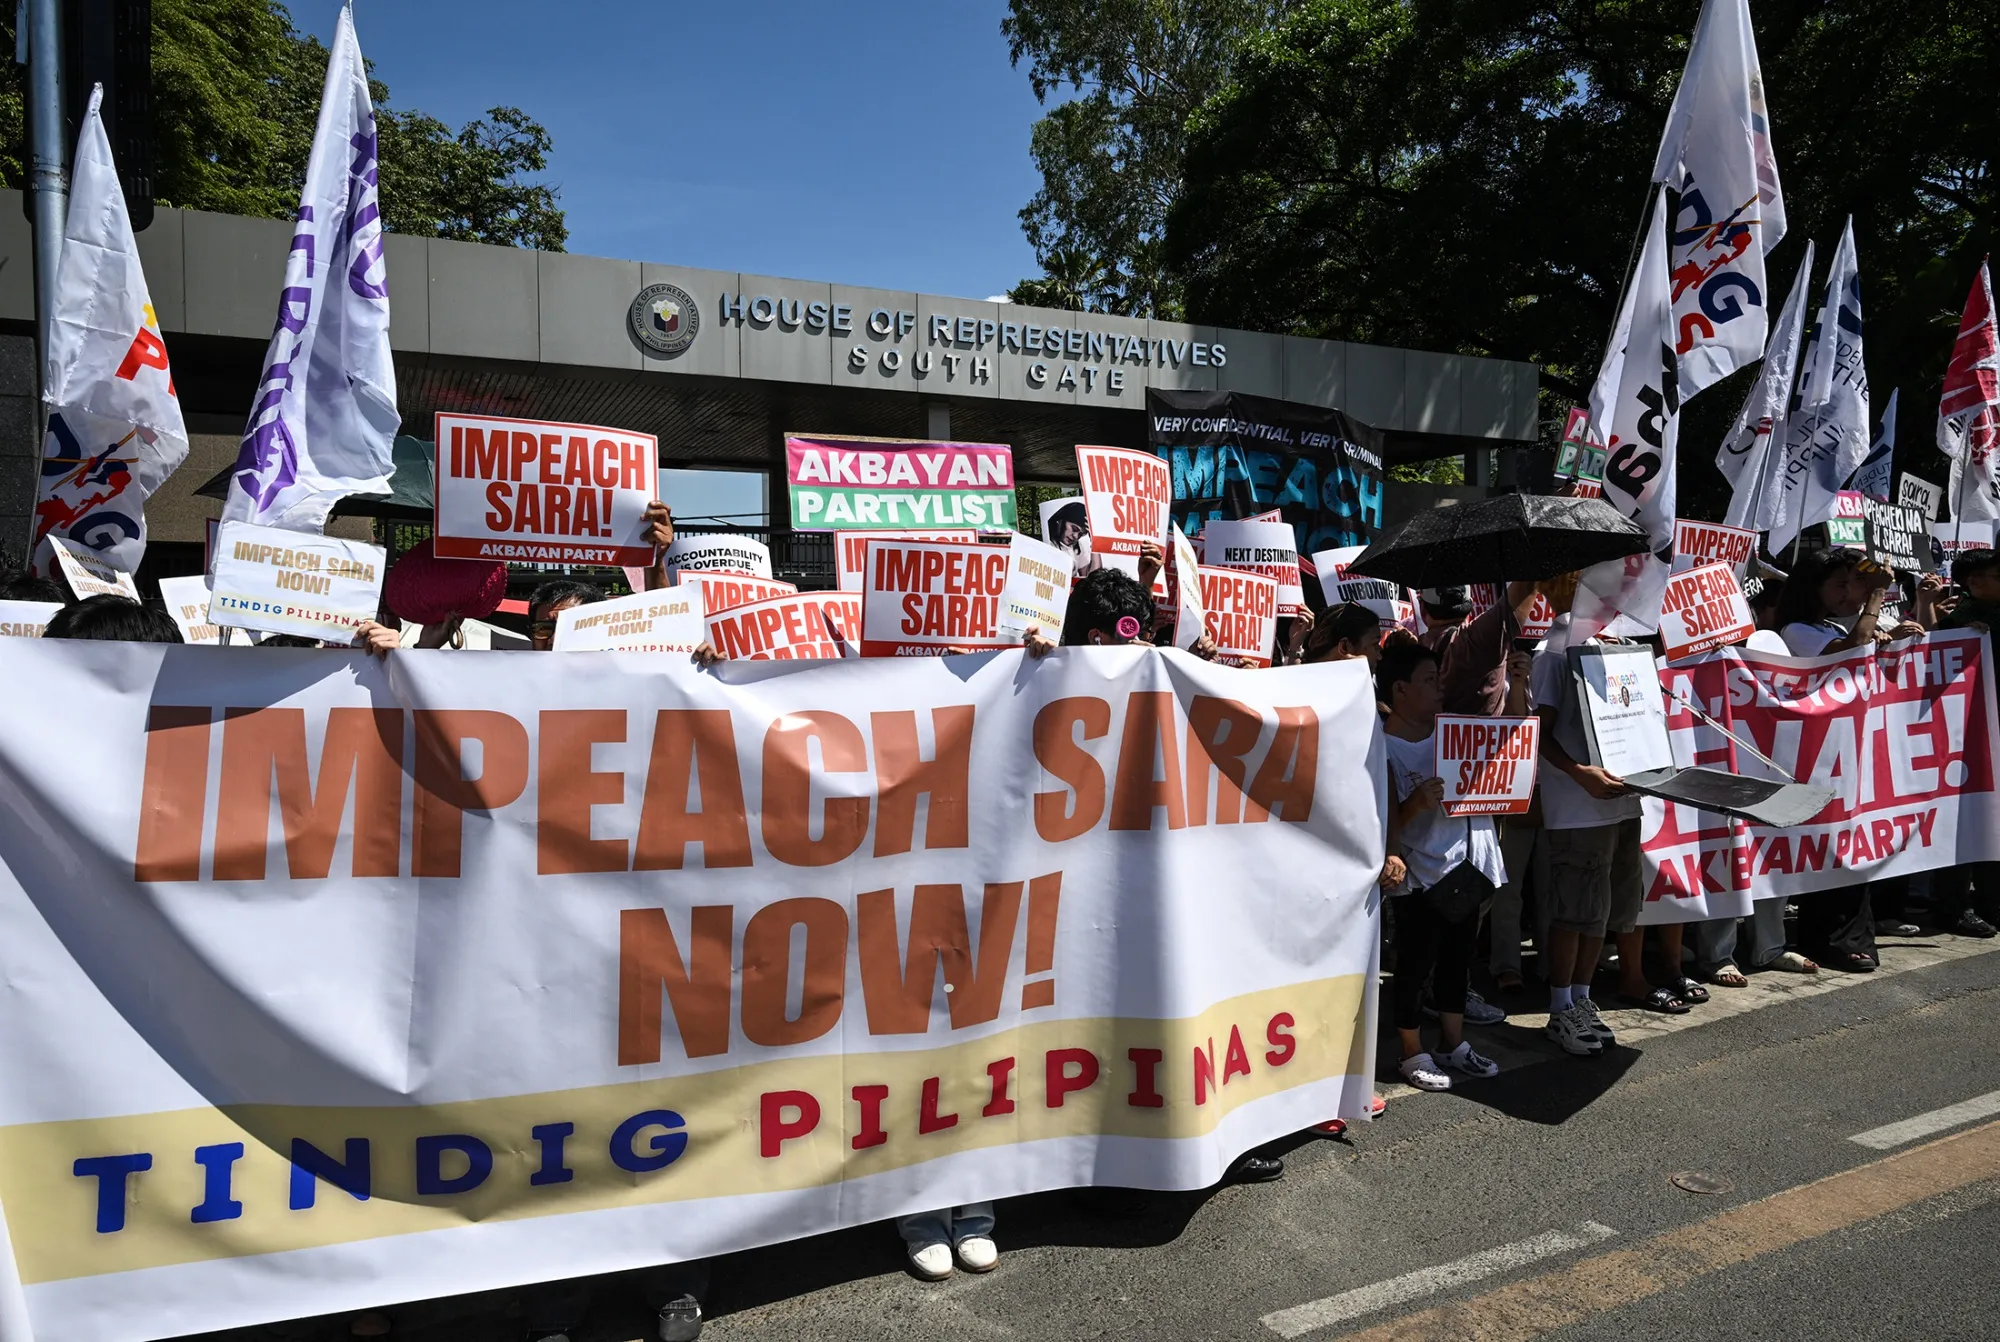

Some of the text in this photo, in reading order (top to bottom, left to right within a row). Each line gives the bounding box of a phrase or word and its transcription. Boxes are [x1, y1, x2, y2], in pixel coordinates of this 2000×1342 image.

[635, 302, 644, 329] HOUSE
[650, 286, 697, 335] REPRESENTATIVES
[645, 335, 687, 349] PHILIPPINES
[723, 292, 1227, 367] HOUSE OF REPRESENTATIVES
[851, 345, 1125, 391] SOUTH GATE
[450, 426, 646, 491] IMPEACH
[1153, 416, 1383, 471] VERY CONFIDENTIAL, VERY CRIMINAL
[796, 450, 1008, 486] AKBAYAN
[1086, 455, 1169, 504] IMPEACH
[1157, 444, 1384, 531] IMPEACH
[1902, 479, 1931, 511] sara,
[485, 481, 613, 538] SARA!
[799, 491, 1008, 525] PARTYLIST
[1112, 495, 1160, 538] SARA!
[1905, 508, 1922, 534] NA
[480, 543, 616, 563] AKBAYAN PARTY
[667, 548, 763, 567] ACCOUNTABILITY
[1111, 541, 1143, 554] AKBAYA
[1225, 548, 1252, 562] NEXT
[1680, 526, 1752, 563] IMPEACH
[1882, 528, 1913, 556] SARA!
[233, 541, 375, 583] IMPEACH SARA
[694, 559, 754, 571] OVERDUE.
[875, 548, 1010, 596] IMPEAC
[1018, 556, 1067, 589] IMPEACH SARA
[276, 569, 331, 596] NOW!
[1035, 581, 1054, 601] NOW!
[1199, 574, 1274, 619] MPEACH
[1336, 578, 1394, 602] UNBOXING
[181, 604, 197, 620] VP
[220, 597, 283, 614] TINDIG
[286, 607, 368, 628] PILIPINA
[574, 602, 689, 631] IMPEACH SARA
[901, 593, 999, 638] SARA!
[1010, 604, 1037, 618] TINDIG
[1278, 604, 1297, 613] YOUTH
[1681, 597, 1738, 638] SARA!
[608, 620, 653, 637] NOW!
[710, 601, 862, 660] IMPEACH
[1204, 611, 1262, 652] SARA!
[1723, 630, 1742, 643] PARTY
[895, 645, 951, 657] AKBAYA
[1728, 667, 1802, 709] SEE
[1897, 647, 1966, 691] THE
[1443, 724, 1533, 760] IMPEACH
[134, 691, 1321, 884] IMPEACH SARA
[1456, 761, 1517, 796] SARA!
[1450, 803, 1511, 813] AKBAYAN PARTY
[1833, 808, 1938, 869] PARTY
[618, 870, 1063, 1067] NOW!
[73, 1010, 1298, 1235] TINDIG PILIPINAS
